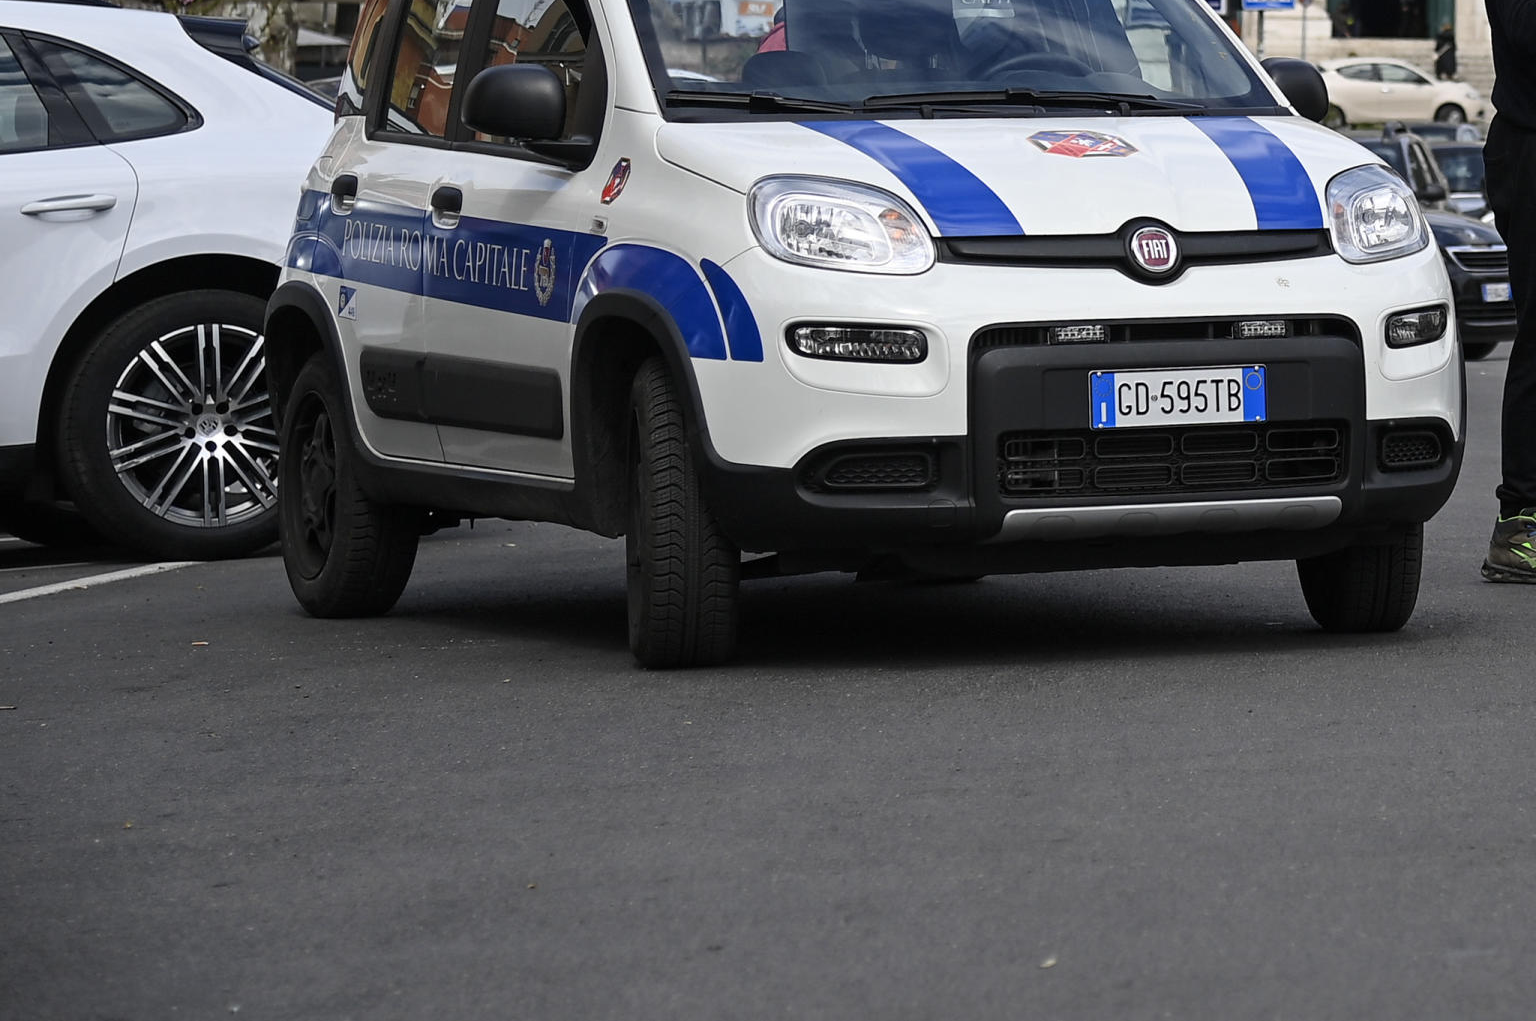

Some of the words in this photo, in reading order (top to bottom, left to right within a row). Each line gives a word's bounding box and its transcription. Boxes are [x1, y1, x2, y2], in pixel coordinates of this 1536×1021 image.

[342, 219, 395, 267] POLIZIA
[400, 228, 449, 278] ROMA
[453, 239, 530, 292] CAPITALE
[1141, 239, 1169, 261] FIAT
